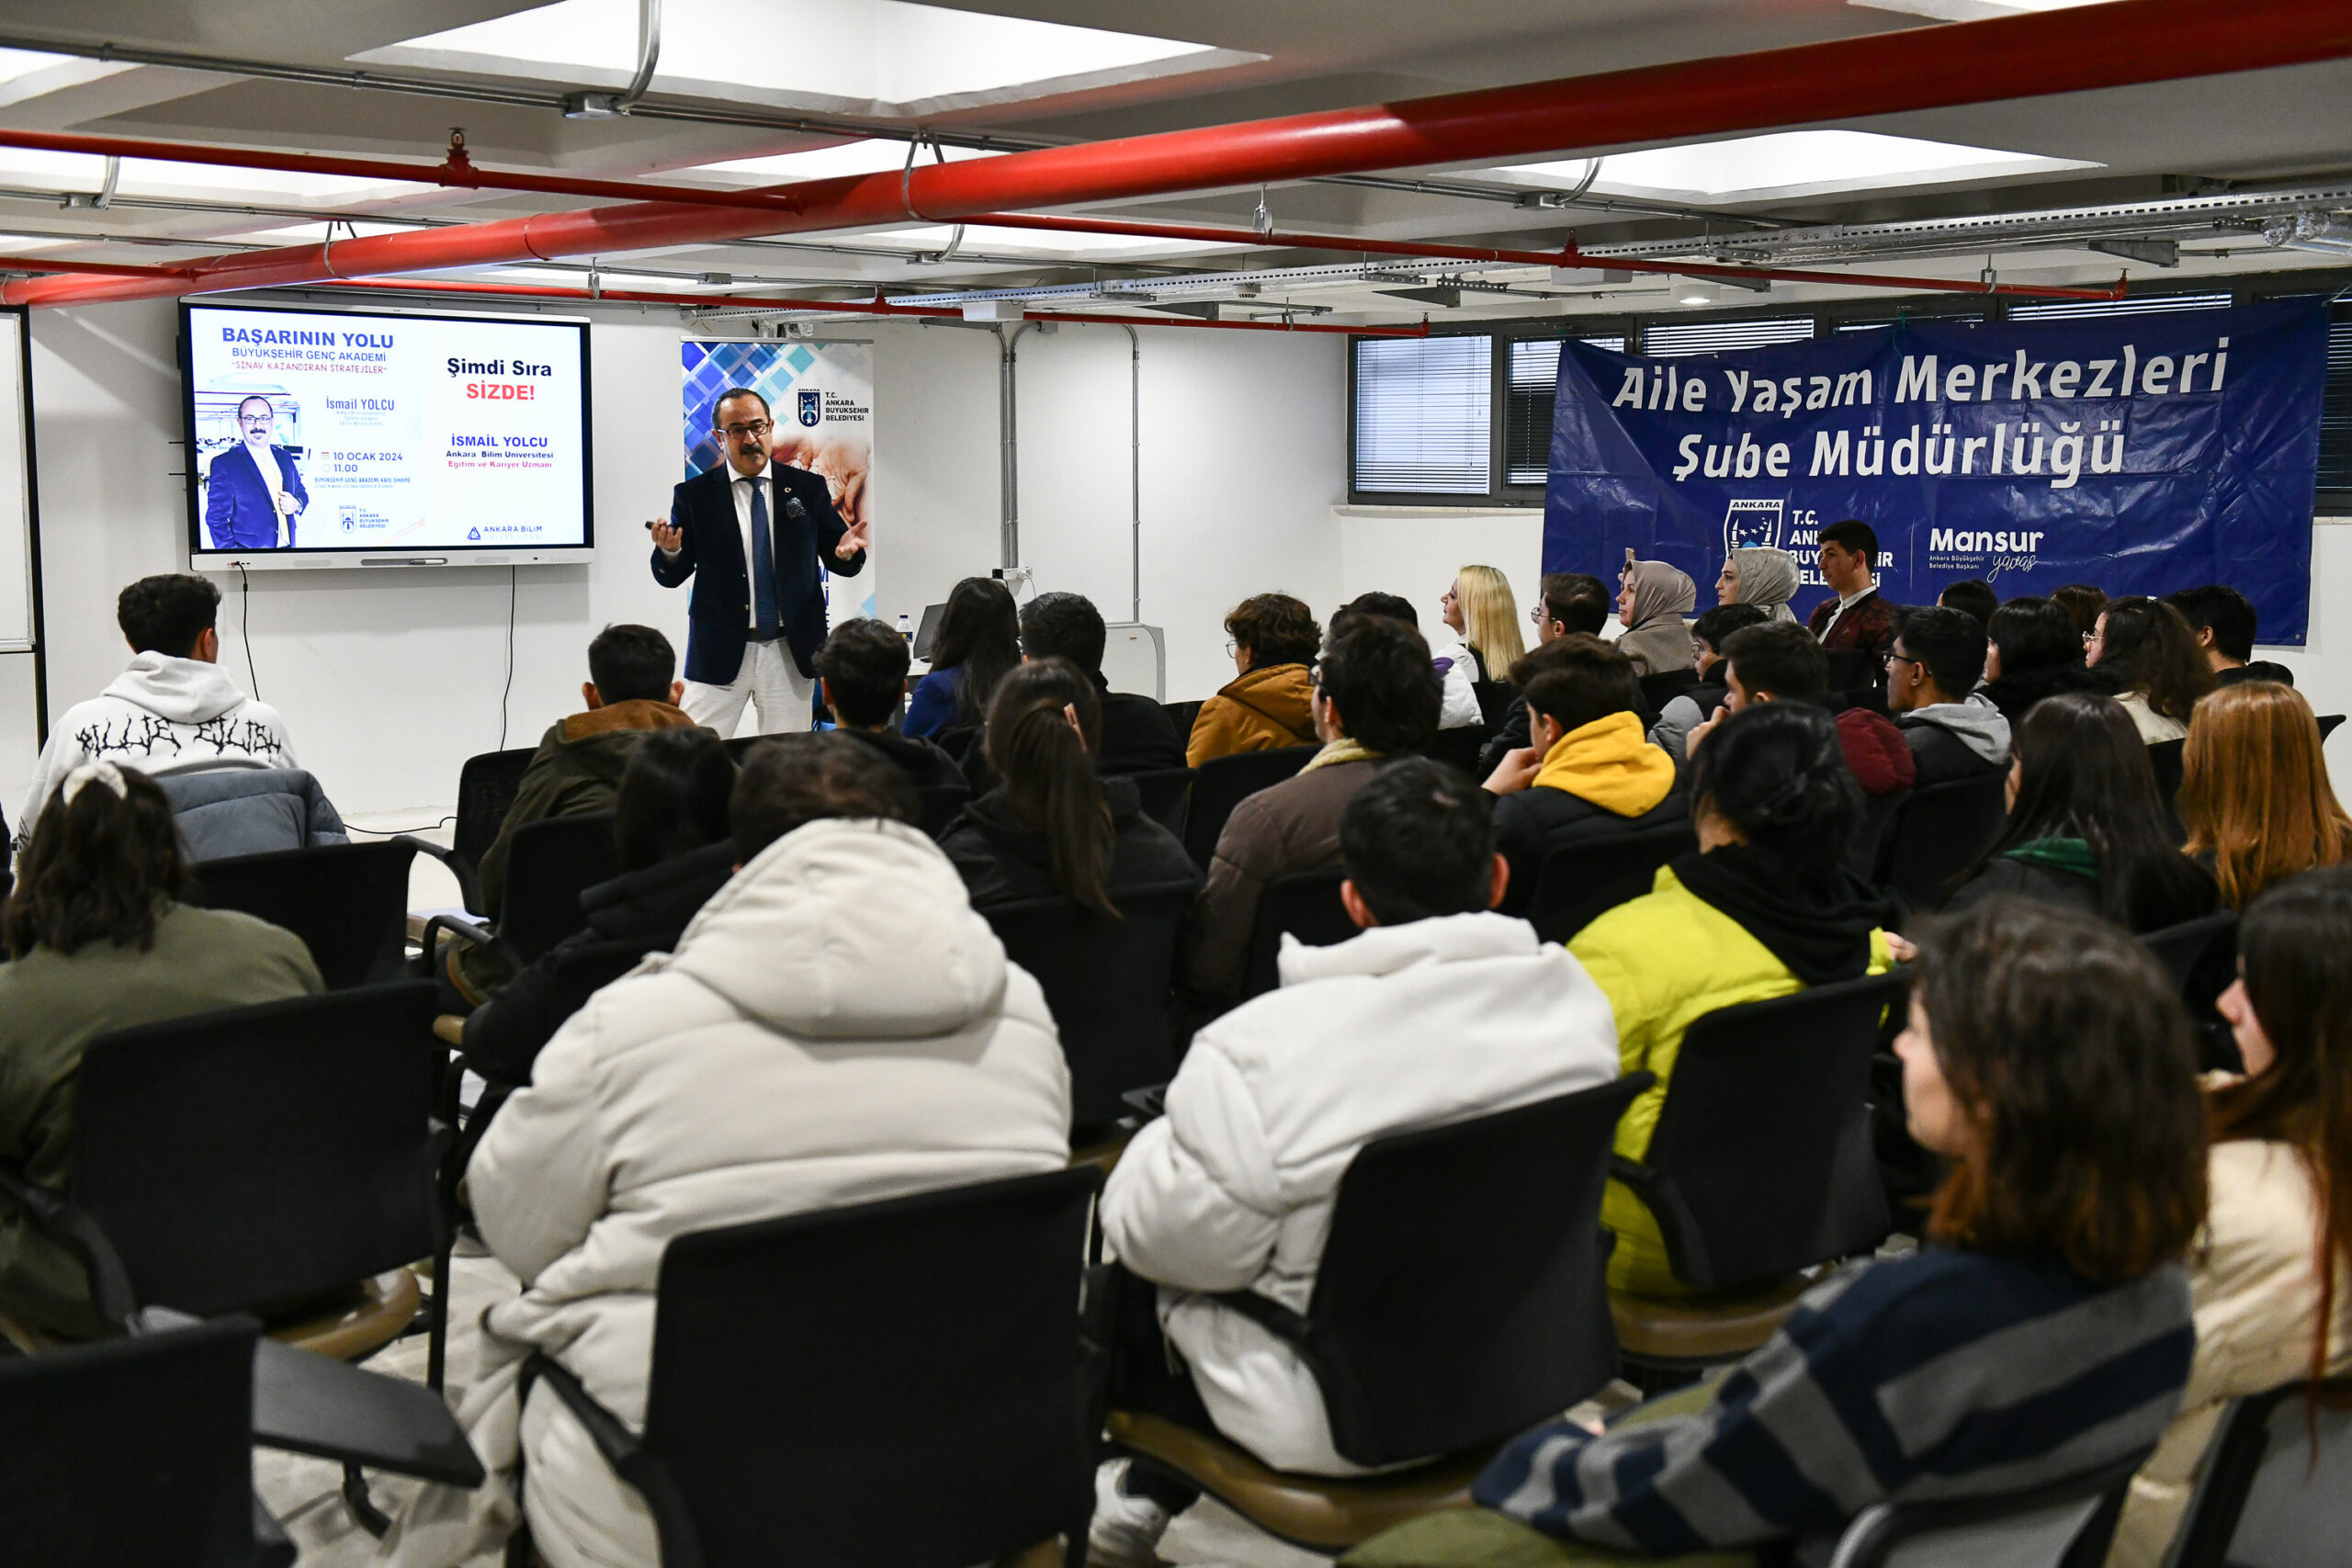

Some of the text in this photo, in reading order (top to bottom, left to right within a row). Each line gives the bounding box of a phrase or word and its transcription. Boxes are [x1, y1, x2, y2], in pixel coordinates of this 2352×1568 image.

[222, 327, 393, 348] BAŞARININ YOLU
[306, 350, 335, 363] GENÇ
[339, 351, 386, 362] AKADEMİ
[447, 357, 551, 378] Şimdi Sıra
[1611, 336, 2230, 419] Aile Yaşam Merkezleri
[467, 379, 535, 400] SİZDE!
[326, 395, 395, 411] İsmail YOLCU
[451, 434, 548, 447] İSMAİL YOLCU
[334, 452, 402, 461] 10 OCAK 2024
[481, 450, 503, 458] Bilim
[1672, 420, 2125, 489] Şube Müdürlüğü
[334, 464, 358, 472] 11.00
[490, 460, 519, 469] Kariyer
[1732, 501, 1781, 509] ANKARA
[1792, 510, 1819, 525] T.C.
[1929, 527, 2044, 552] Mansur
